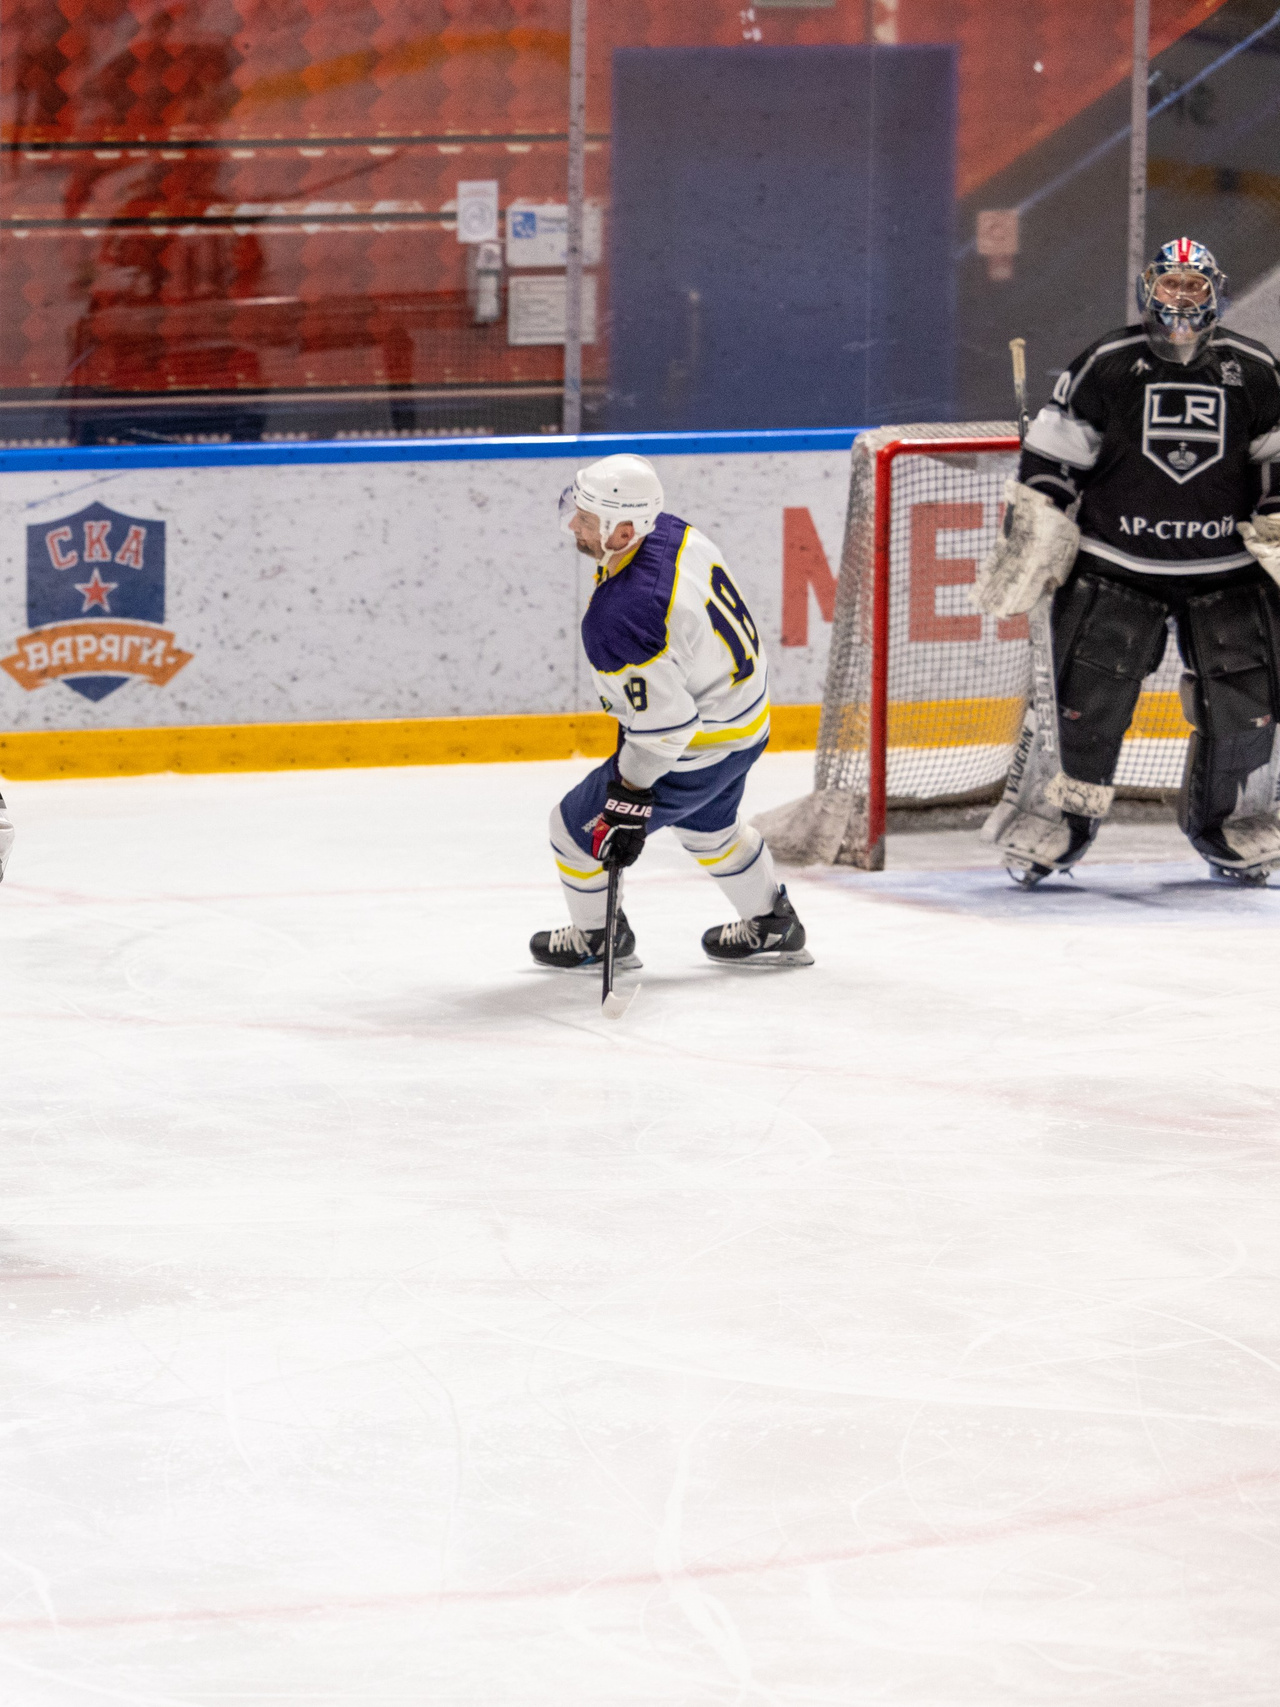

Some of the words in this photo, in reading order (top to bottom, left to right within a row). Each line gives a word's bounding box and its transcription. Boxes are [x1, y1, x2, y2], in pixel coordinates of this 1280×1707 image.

[1151, 394, 1217, 427] LR
[46, 520, 147, 571] СКА
[705, 563, 759, 688] 18
[22, 633, 168, 673] ВАРЯГИ
